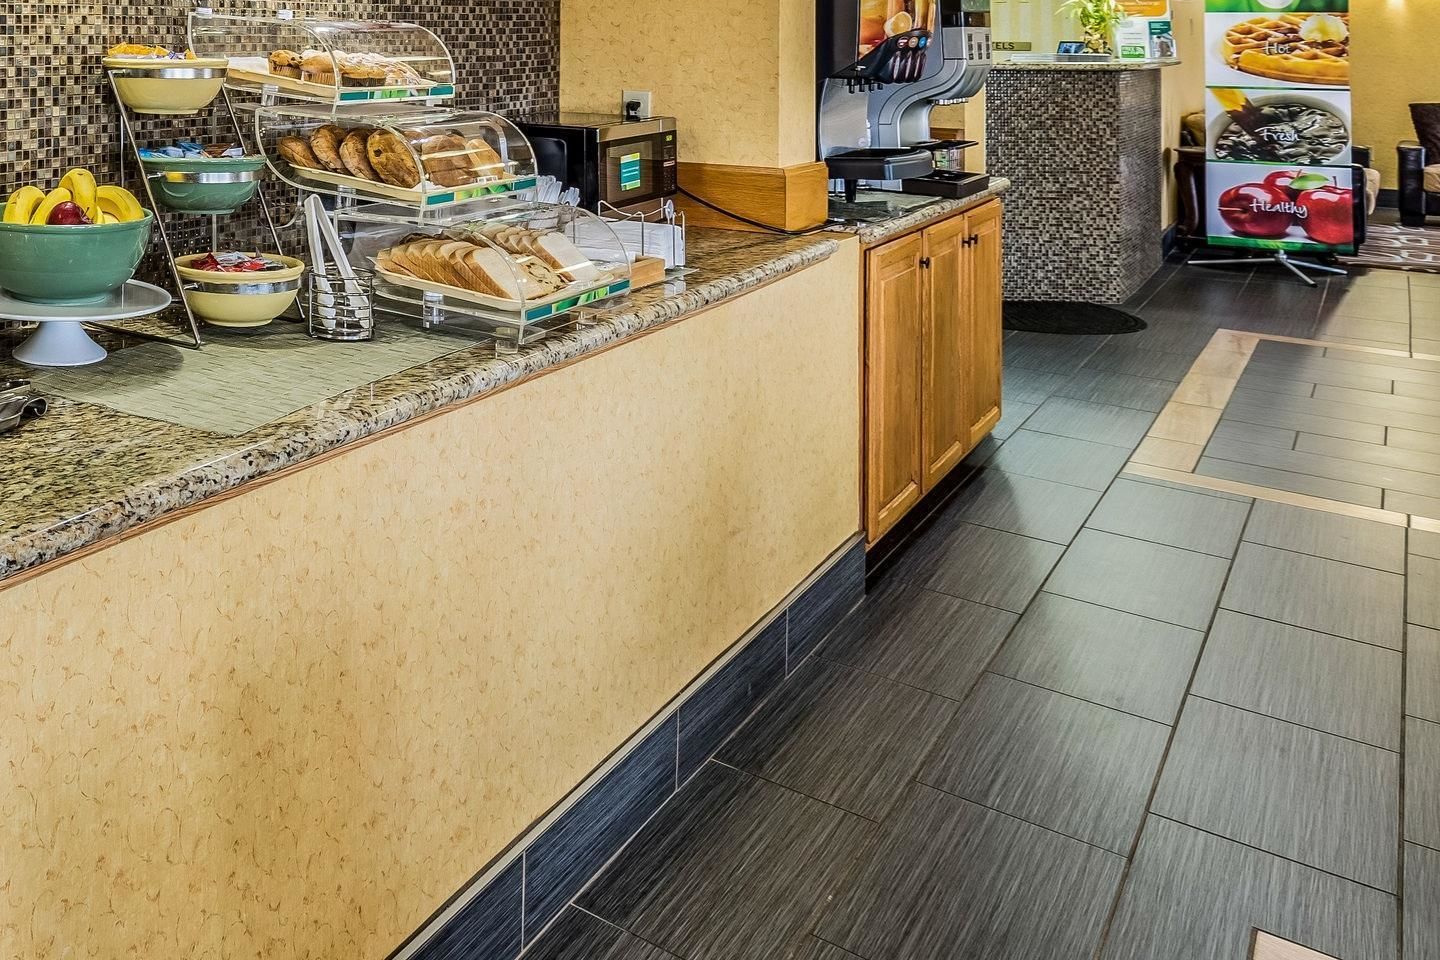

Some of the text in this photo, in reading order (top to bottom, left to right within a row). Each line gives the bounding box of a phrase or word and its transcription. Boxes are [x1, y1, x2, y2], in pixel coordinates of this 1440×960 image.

[1264, 41, 1291, 56] Hot
[1255, 126, 1300, 142] Fresh
[1249, 198, 1309, 218] Healthy
